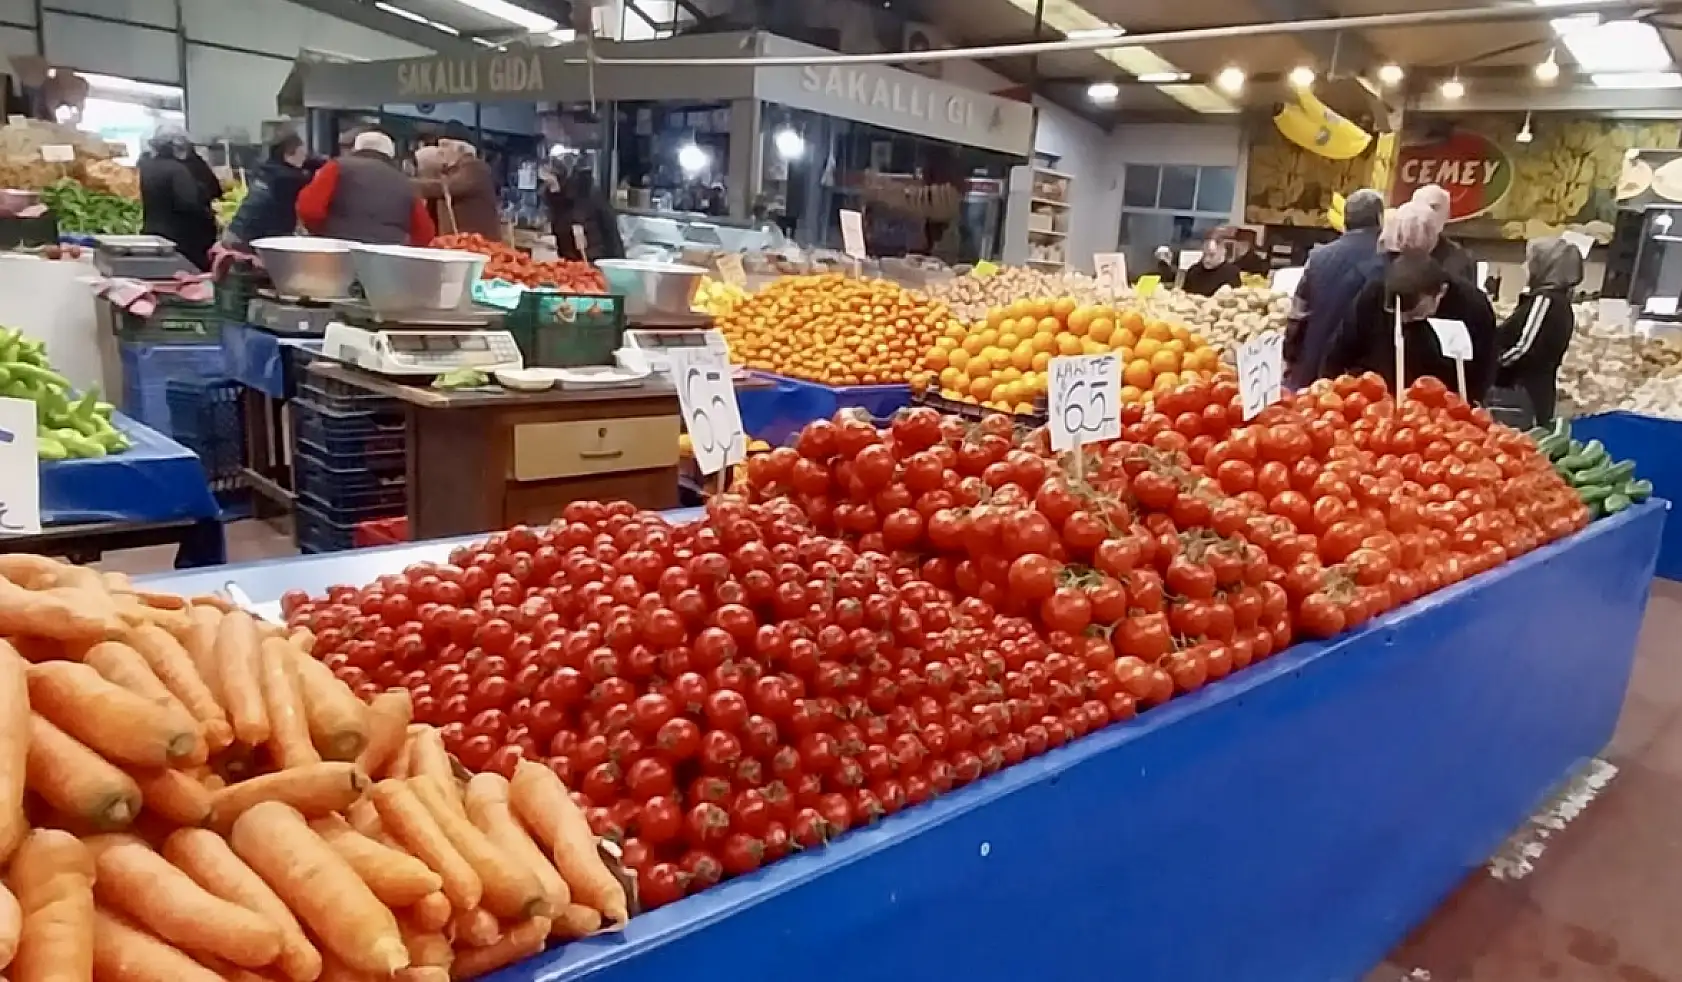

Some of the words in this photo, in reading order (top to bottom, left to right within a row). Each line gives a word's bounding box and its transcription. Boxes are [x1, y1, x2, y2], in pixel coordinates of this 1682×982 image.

[397, 60, 479, 94] SAKALLI
[490, 54, 544, 92] GIDA
[802, 65, 936, 122] SAKALLI
[1401, 158, 1500, 185] CEMEY
